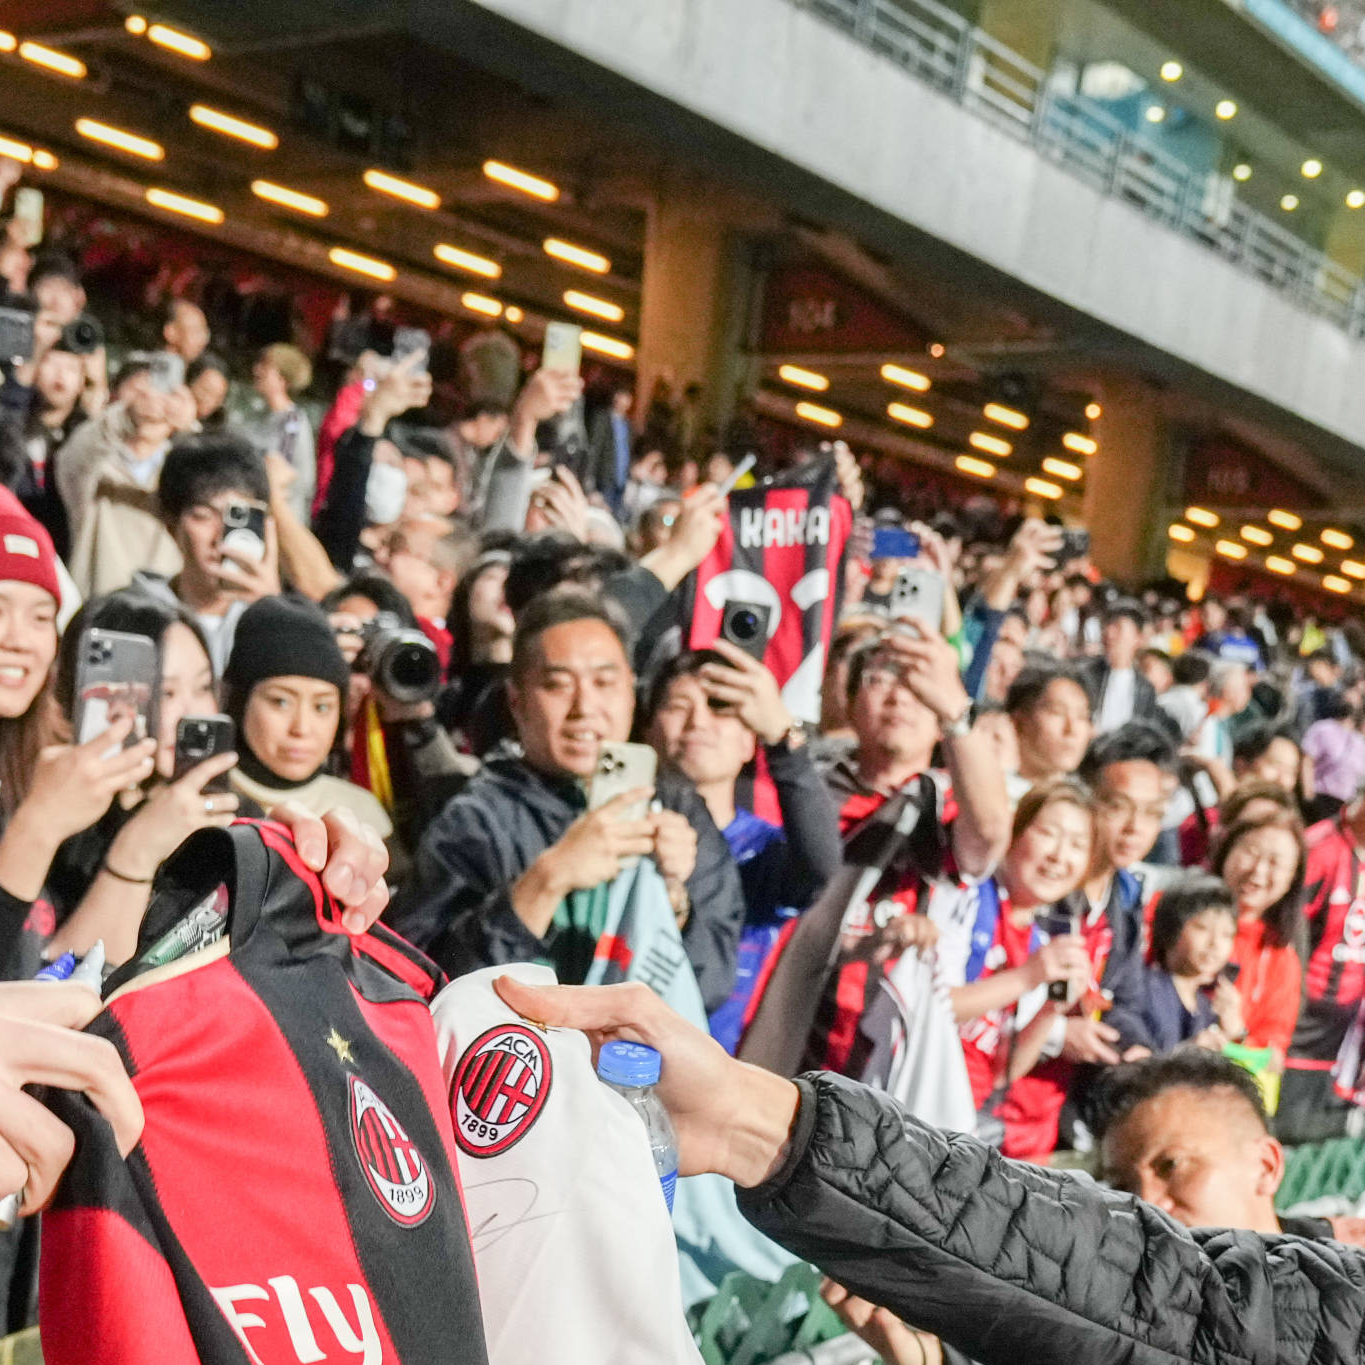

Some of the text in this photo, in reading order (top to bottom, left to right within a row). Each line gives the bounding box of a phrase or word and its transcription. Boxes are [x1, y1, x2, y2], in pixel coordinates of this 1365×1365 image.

[740, 506, 830, 548] KAKA
[494, 1036, 537, 1069] ACM
[461, 1113, 498, 1141] 1899
[388, 1186, 424, 1205] 1899
